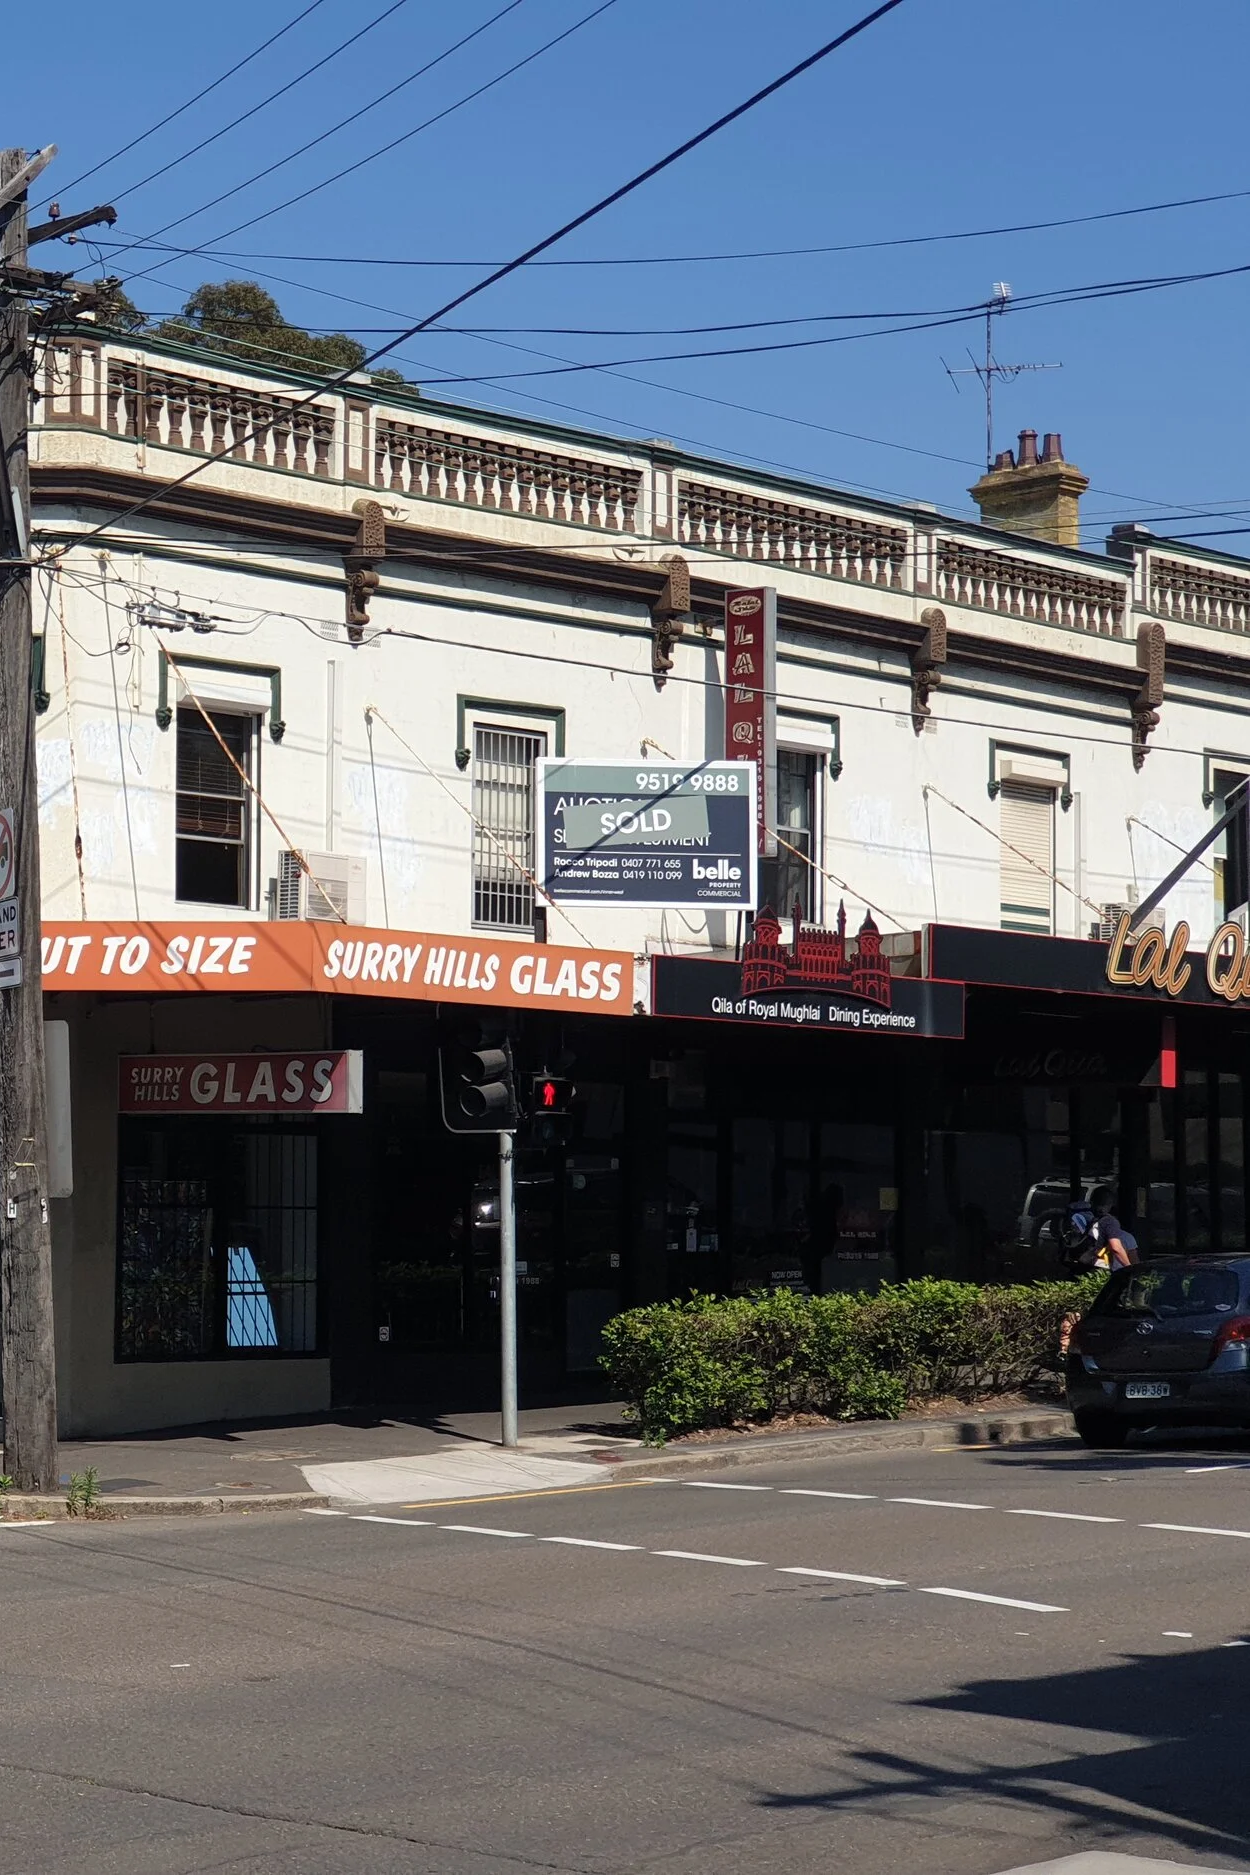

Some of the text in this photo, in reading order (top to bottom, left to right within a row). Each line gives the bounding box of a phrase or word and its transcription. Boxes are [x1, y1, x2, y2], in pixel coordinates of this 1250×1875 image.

[636, 772, 739, 792] 9519 9888
[600, 808, 672, 836] SOLD
[553, 857, 681, 869] Rocco Tripodi 0407 771 655
[554, 868, 683, 881] Andrew Bozza 0419 110 099
[692, 859, 742, 880] belle
[697, 889, 742, 897] COMMERCIAL
[41, 936, 92, 975] UT
[100, 936, 150, 975] TO
[160, 935, 257, 975] SIZE
[1106, 910, 1192, 996] Lal
[323, 939, 622, 1001] SURRY HILLS GLASS
[712, 997, 915, 1028] Qila of Royal Mughlai Dining Experience
[130, 1059, 334, 1104] SURRY GLASS
[134, 1085, 180, 1101] HILLS
